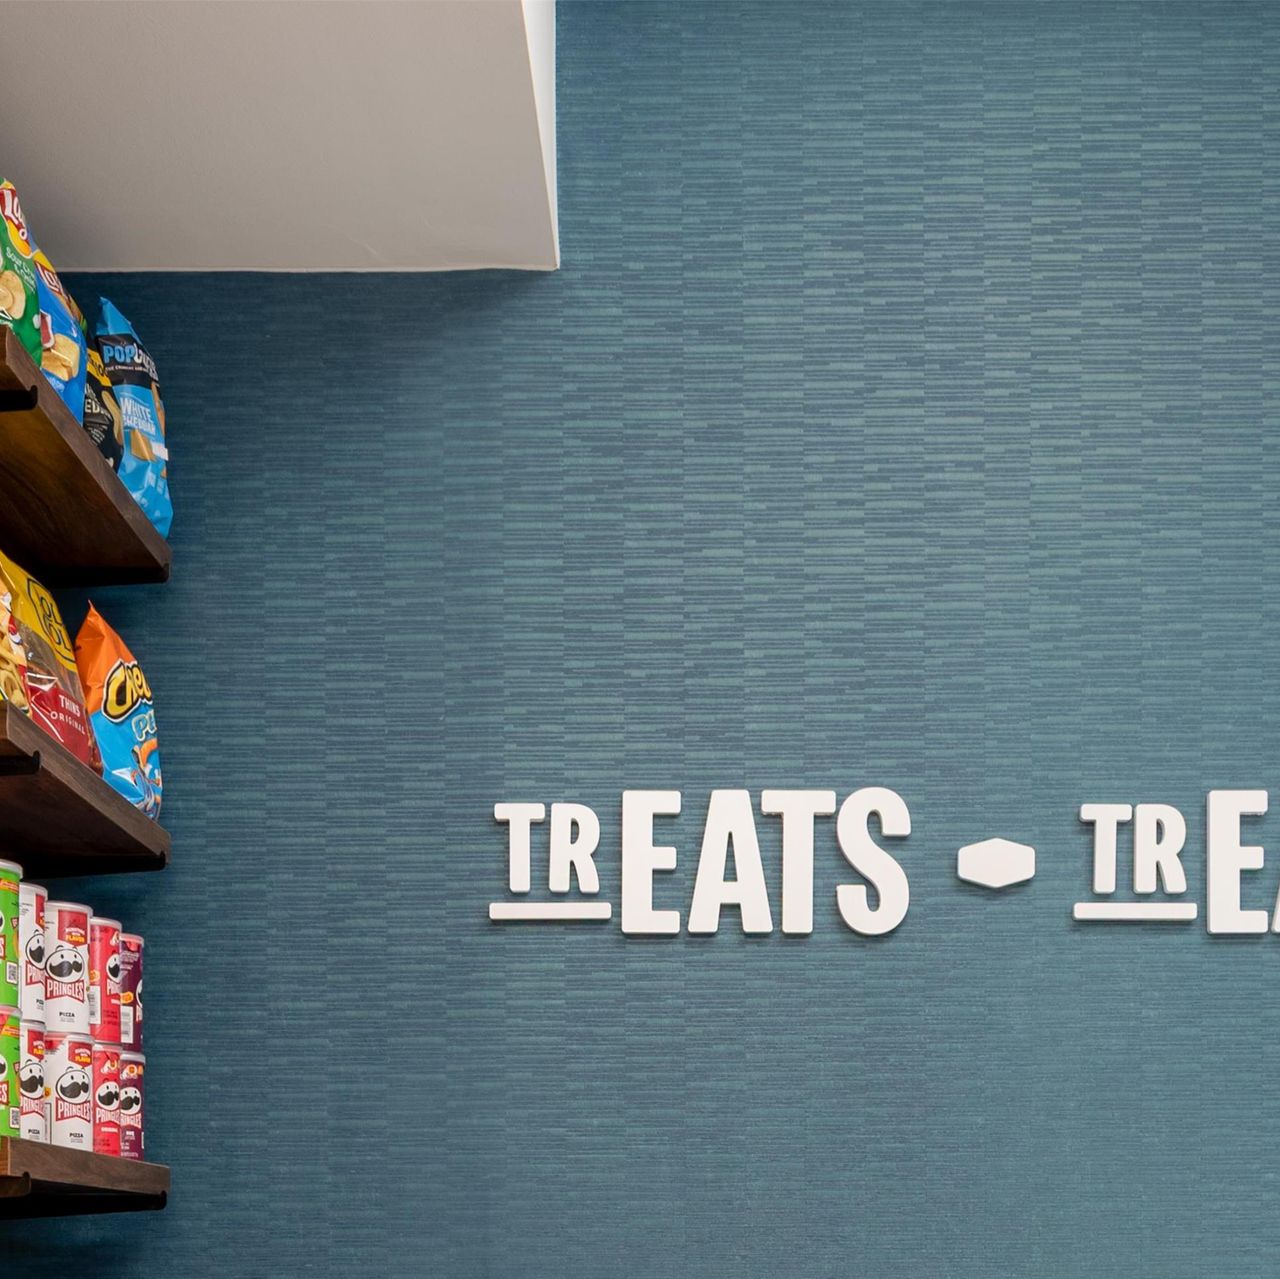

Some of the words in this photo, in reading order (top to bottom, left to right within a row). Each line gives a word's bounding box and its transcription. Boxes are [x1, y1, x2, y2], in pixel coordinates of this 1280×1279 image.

[121, 397, 152, 420] WHITE
[59, 695, 81, 717] THINS
[51, 711, 86, 736] ORIGINAL
[493, 786, 911, 935] TREATS
[46, 981, 84, 1001] PRINGLES
[58, 1102, 91, 1122] PRINGLES
[69, 1131, 84, 1139] PIZZA
